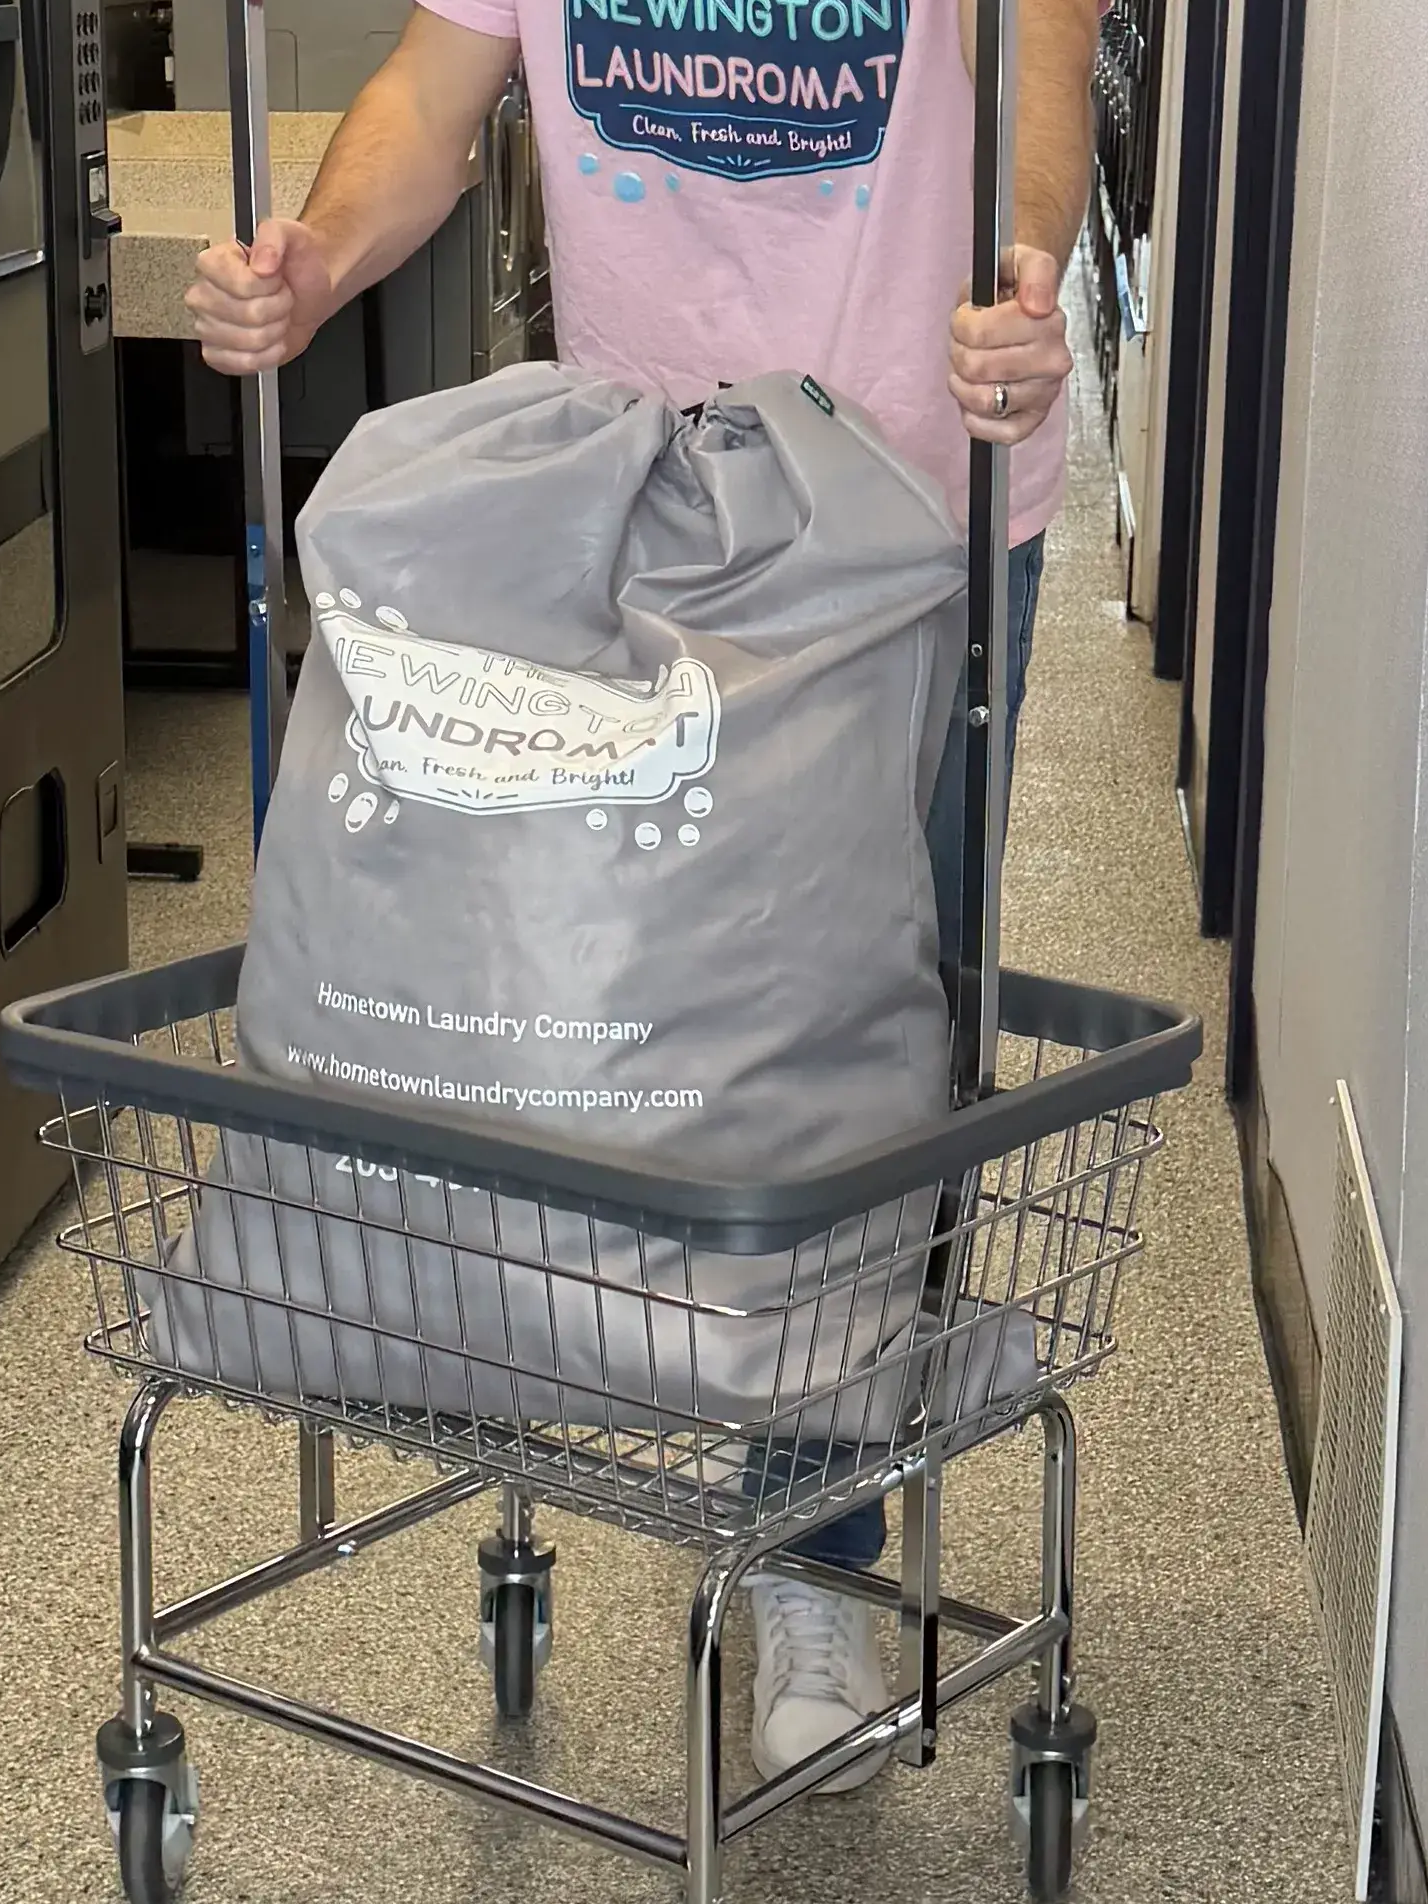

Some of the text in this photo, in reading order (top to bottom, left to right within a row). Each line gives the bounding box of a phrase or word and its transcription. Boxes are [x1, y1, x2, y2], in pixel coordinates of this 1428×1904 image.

[575, 43, 898, 111] LAUNDROMAT
[690, 121, 742, 144] Fresh
[746, 128, 782, 146] and
[422, 756, 489, 782] Fresh
[494, 768, 540, 784] and
[318, 981, 654, 1045] Hometown Laundry Company
[286, 1044, 704, 1113] www.hometownlaundrycompany.com
